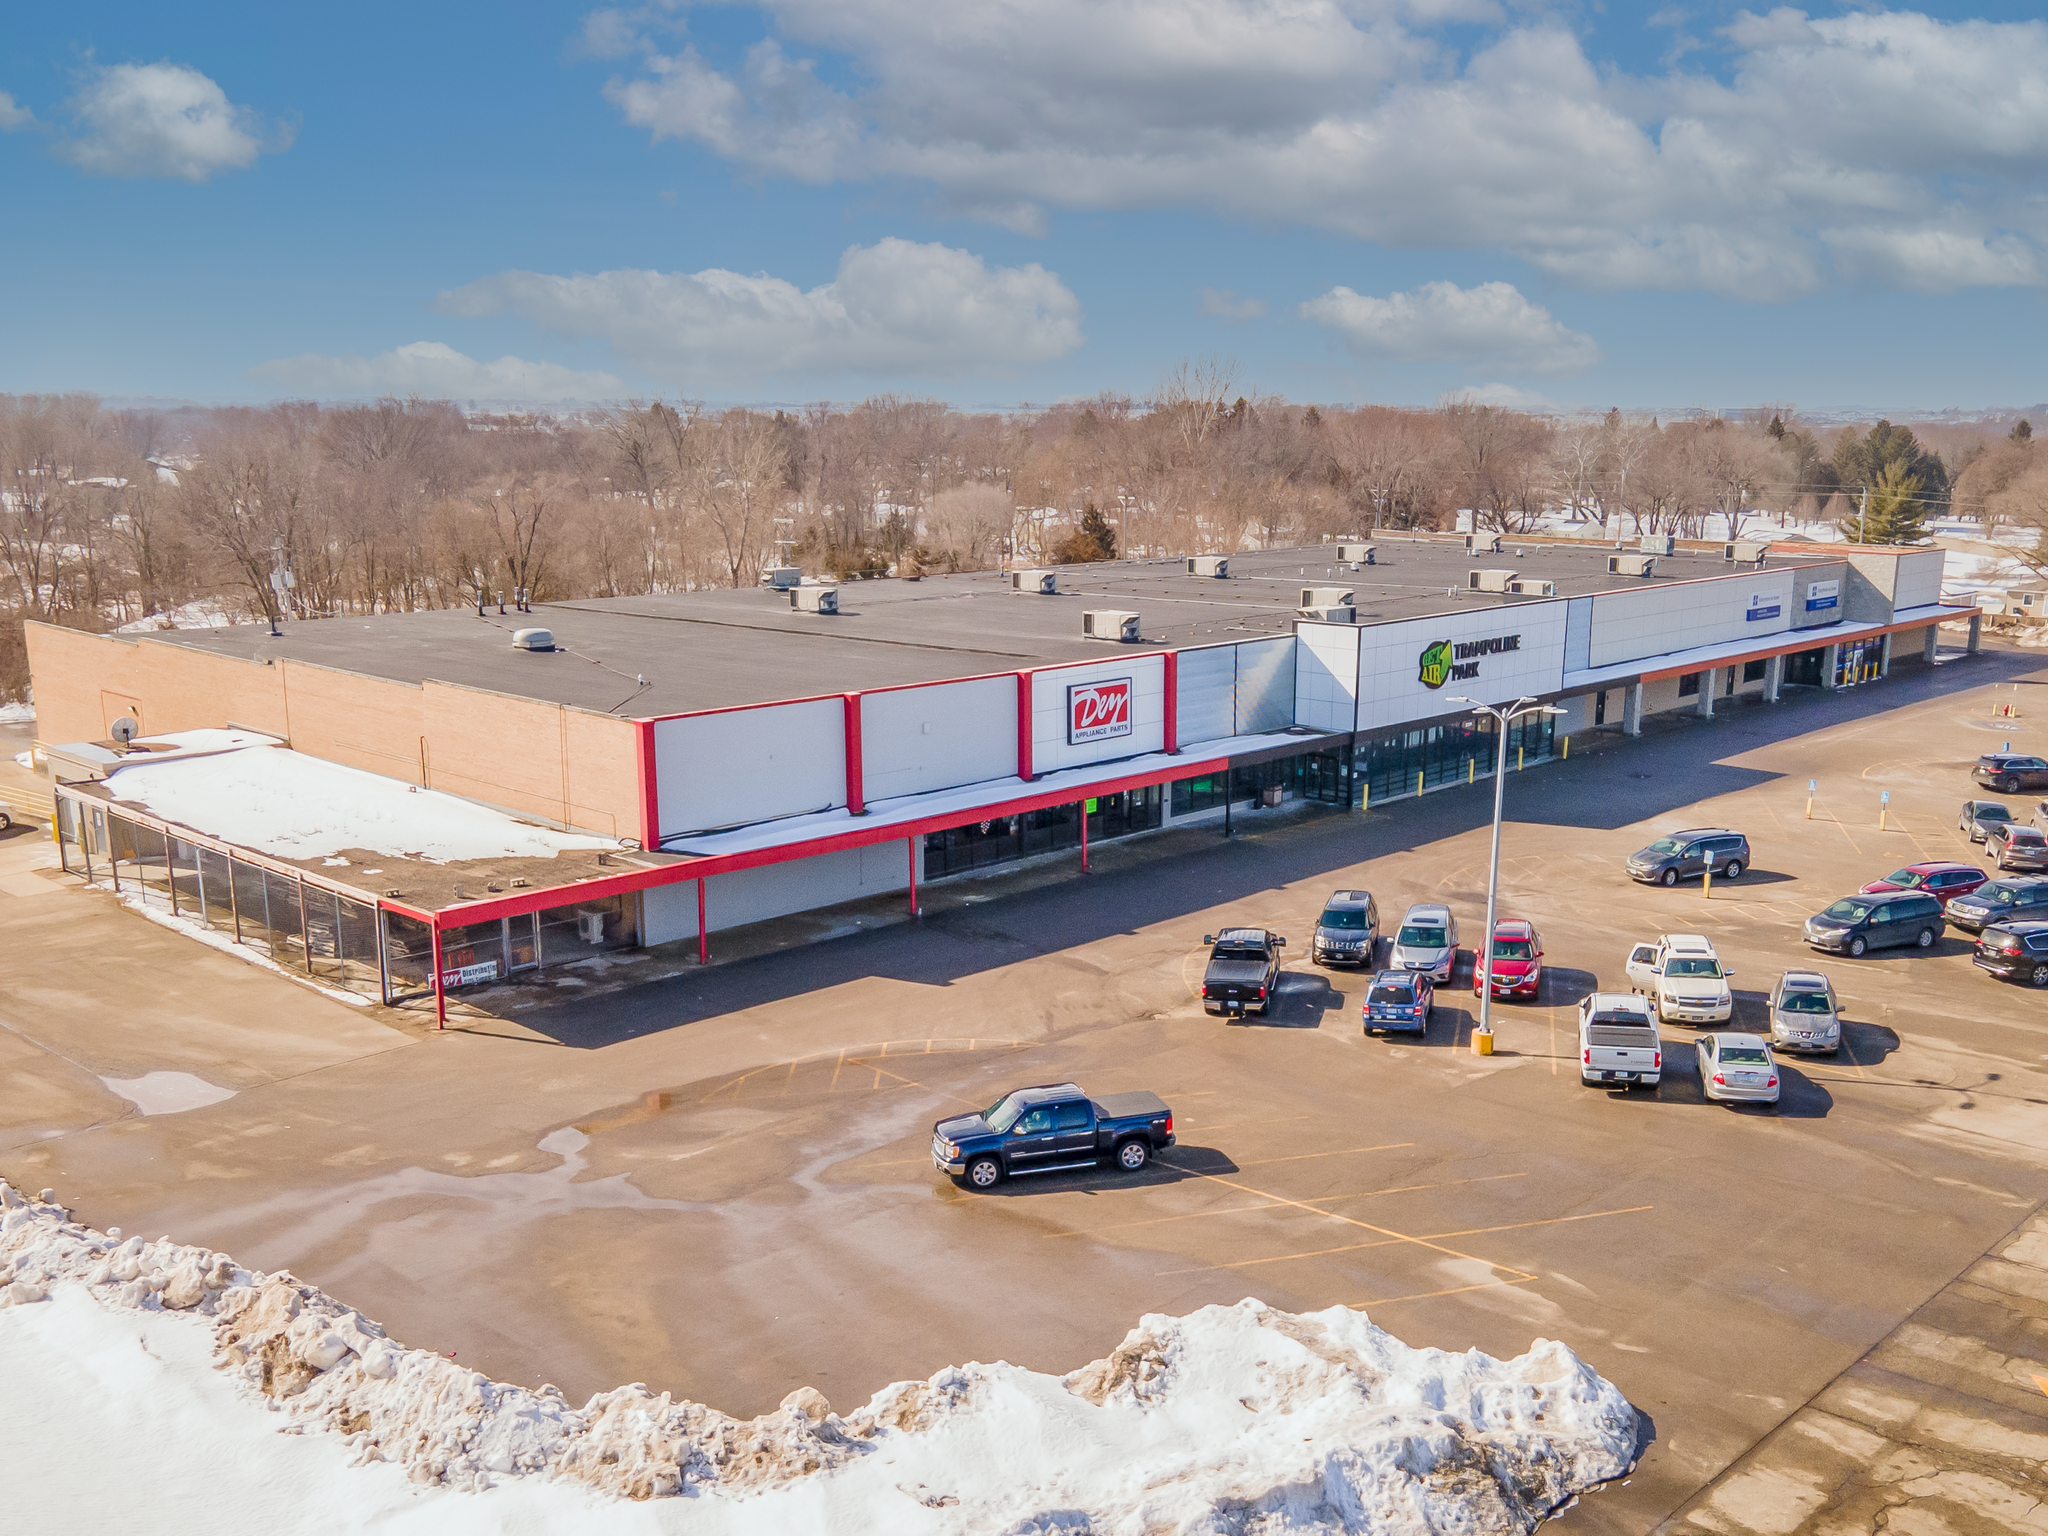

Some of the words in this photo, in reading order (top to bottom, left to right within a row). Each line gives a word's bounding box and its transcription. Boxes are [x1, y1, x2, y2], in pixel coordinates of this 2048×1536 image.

[1453, 634, 1521, 660] TRAMPOLINE
[1421, 664, 1442, 686] AIR
[1451, 661, 1480, 681] PARK
[1074, 727, 1107, 739] APPLIANCE
[1109, 724, 1128, 733] PARTS
